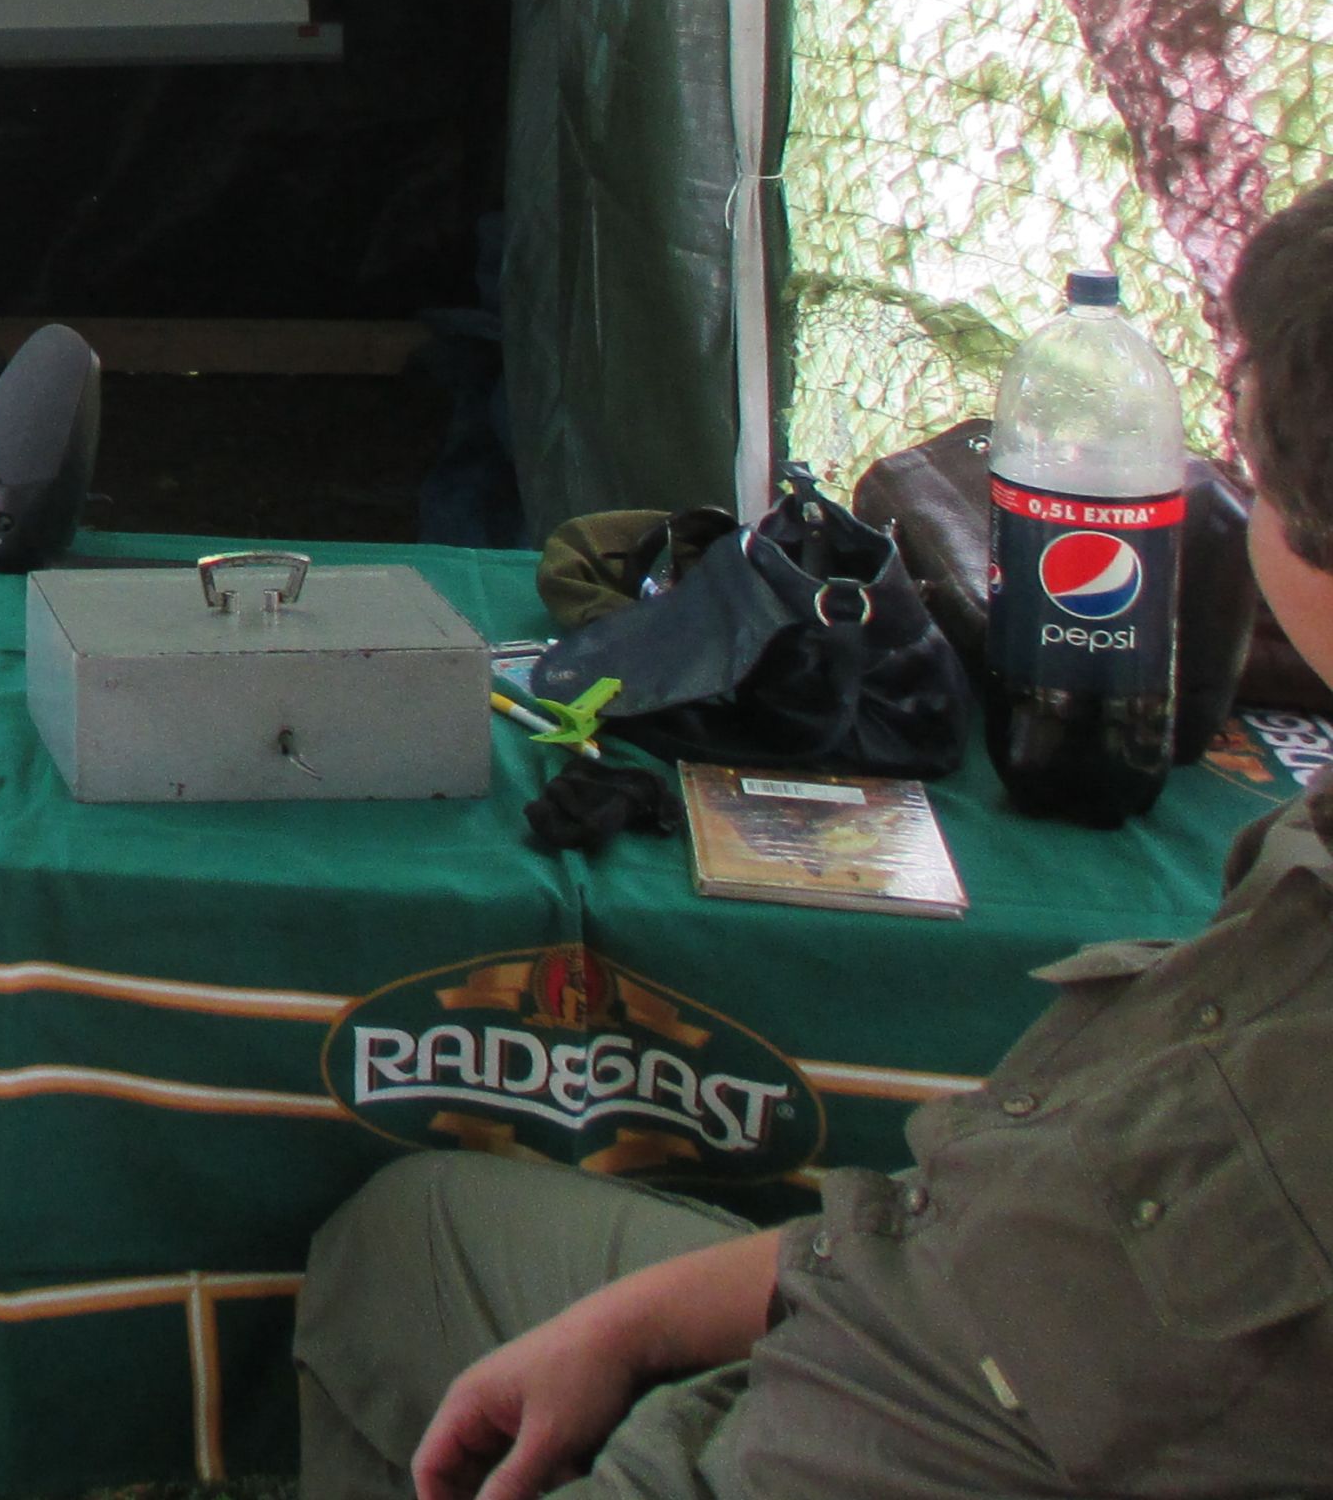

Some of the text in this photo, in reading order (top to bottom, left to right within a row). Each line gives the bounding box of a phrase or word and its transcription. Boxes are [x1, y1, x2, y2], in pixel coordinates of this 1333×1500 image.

[1028, 498, 1077, 521] 0,5L
[1041, 623, 1136, 653] pepsi
[353, 1024, 789, 1152] RADEGAST
